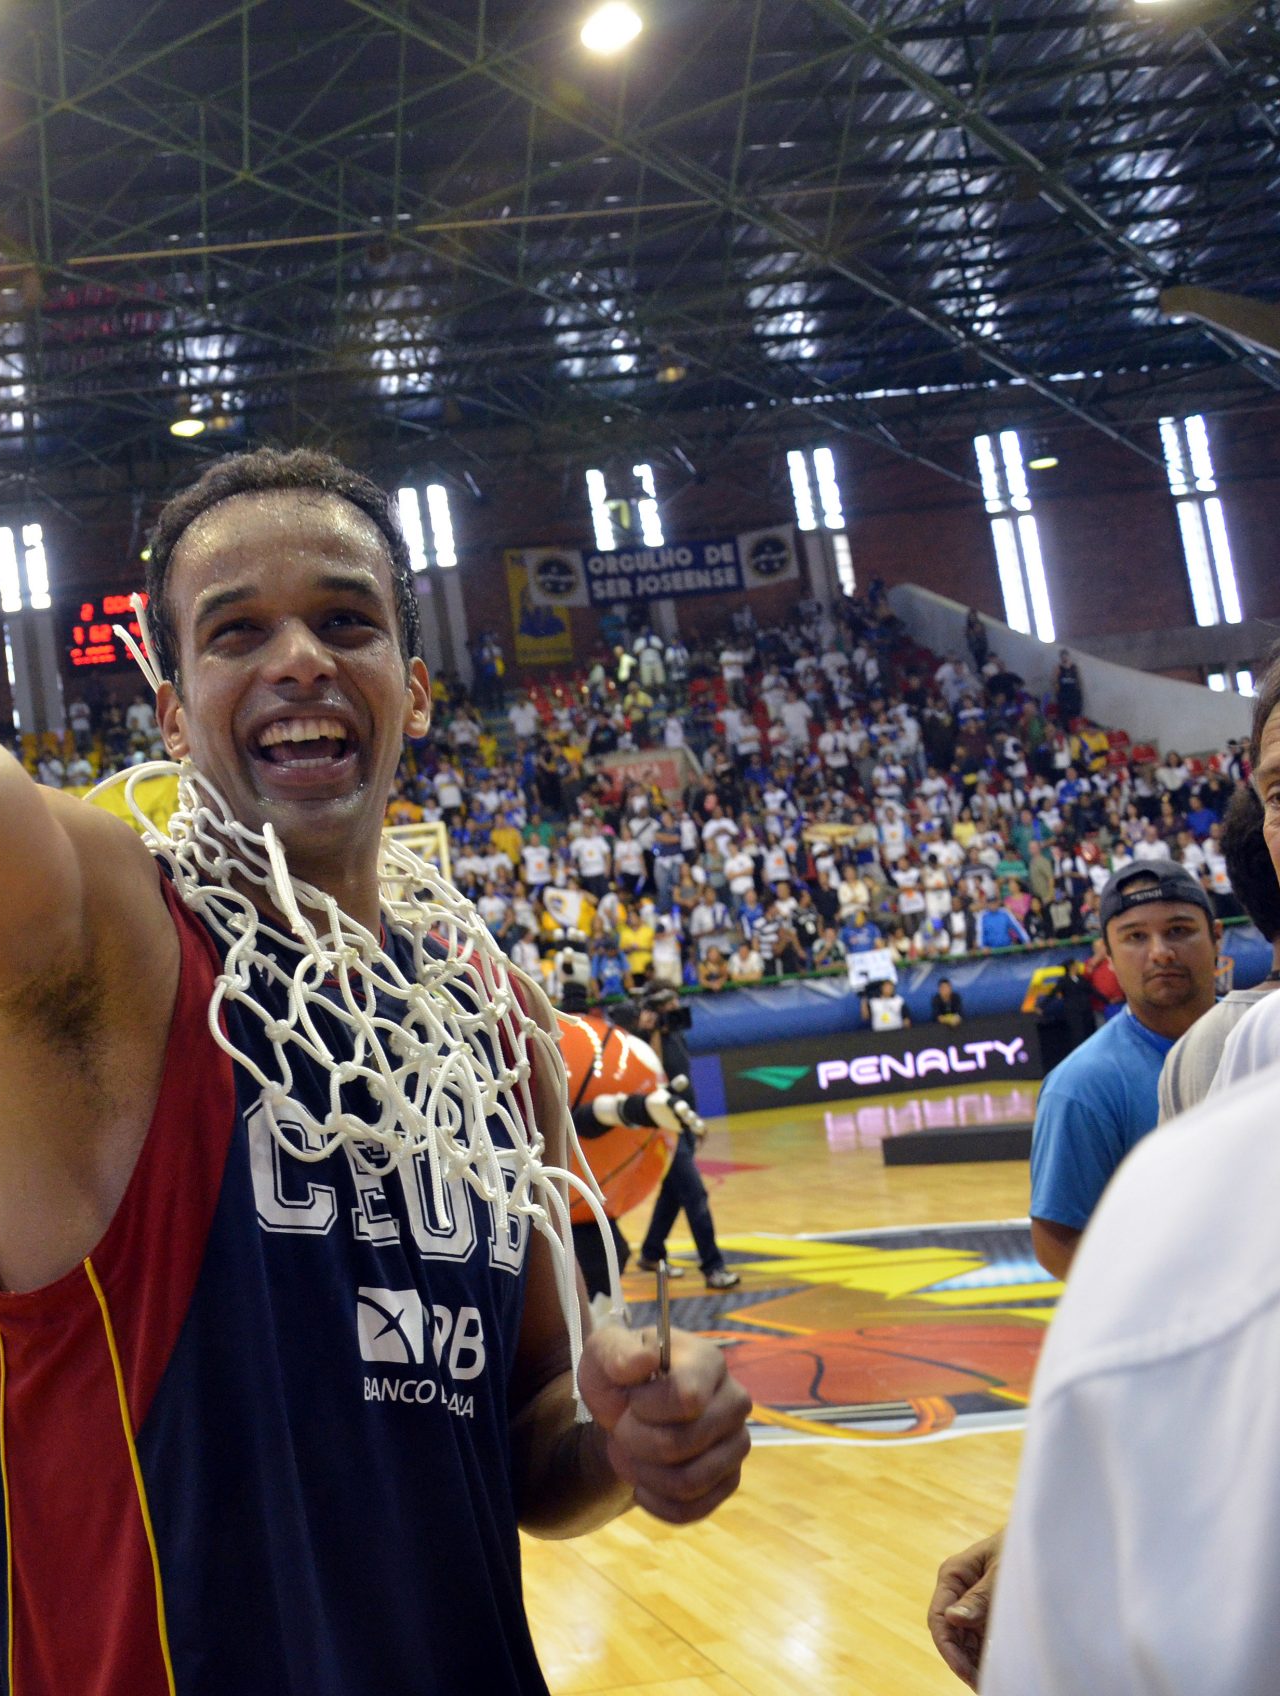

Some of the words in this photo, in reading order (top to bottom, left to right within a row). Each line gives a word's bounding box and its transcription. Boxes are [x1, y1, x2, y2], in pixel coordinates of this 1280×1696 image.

[587, 547, 694, 577] ORGULHO
[703, 542, 736, 565] DE
[591, 578, 633, 600] SER
[634, 566, 738, 594] JOSEENSE
[816, 1036, 1024, 1090] PENALTY
[363, 1376, 437, 1404] BANCO
